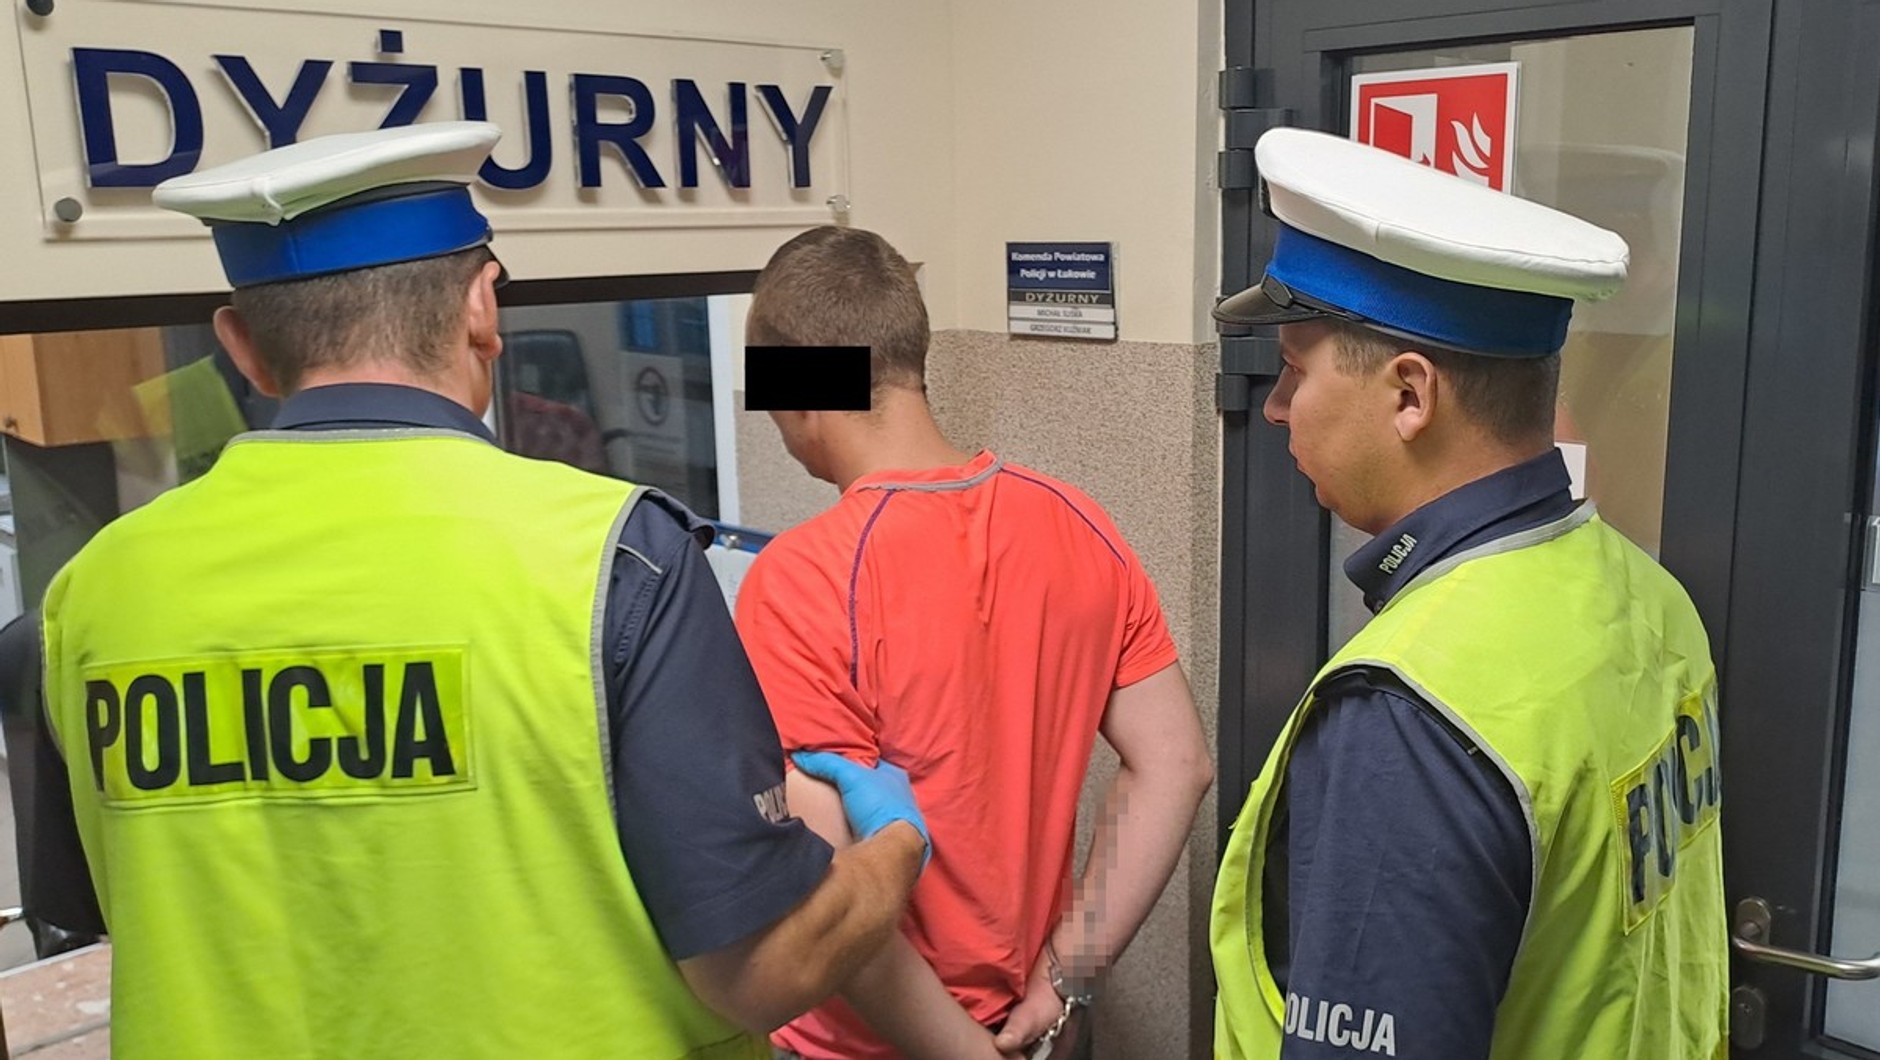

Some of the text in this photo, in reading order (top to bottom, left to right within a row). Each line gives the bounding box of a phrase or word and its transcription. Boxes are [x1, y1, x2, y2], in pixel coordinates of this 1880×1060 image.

[71, 29, 834, 189] DYŻURNY
[1011, 252, 1105, 262] Komenda Powiatowa
[1020, 268, 1047, 281] Policji
[1047, 271, 1056, 279] w
[1379, 533, 1418, 575] POLICJA
[86, 661, 456, 792] POLICJA
[1285, 991, 1396, 1057] OLICJA
